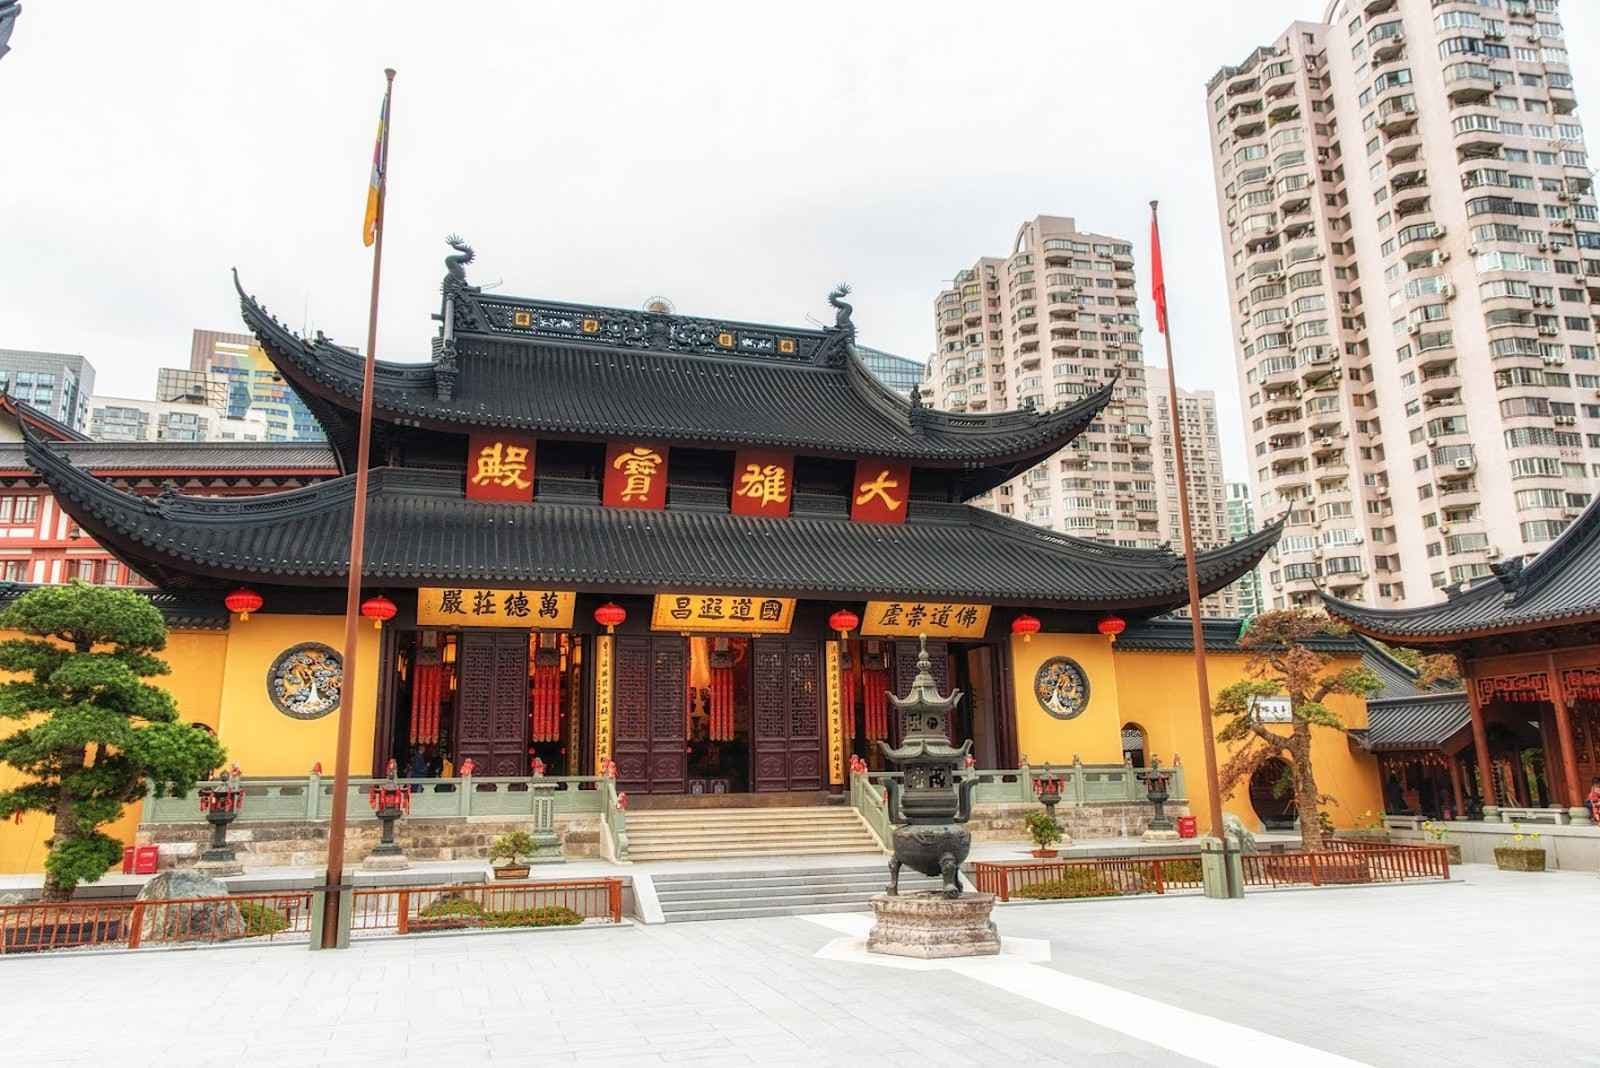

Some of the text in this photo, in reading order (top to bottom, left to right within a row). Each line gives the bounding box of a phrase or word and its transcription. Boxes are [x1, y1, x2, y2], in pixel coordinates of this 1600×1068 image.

[471, 442, 903, 511] 大 雄 寶 殿
